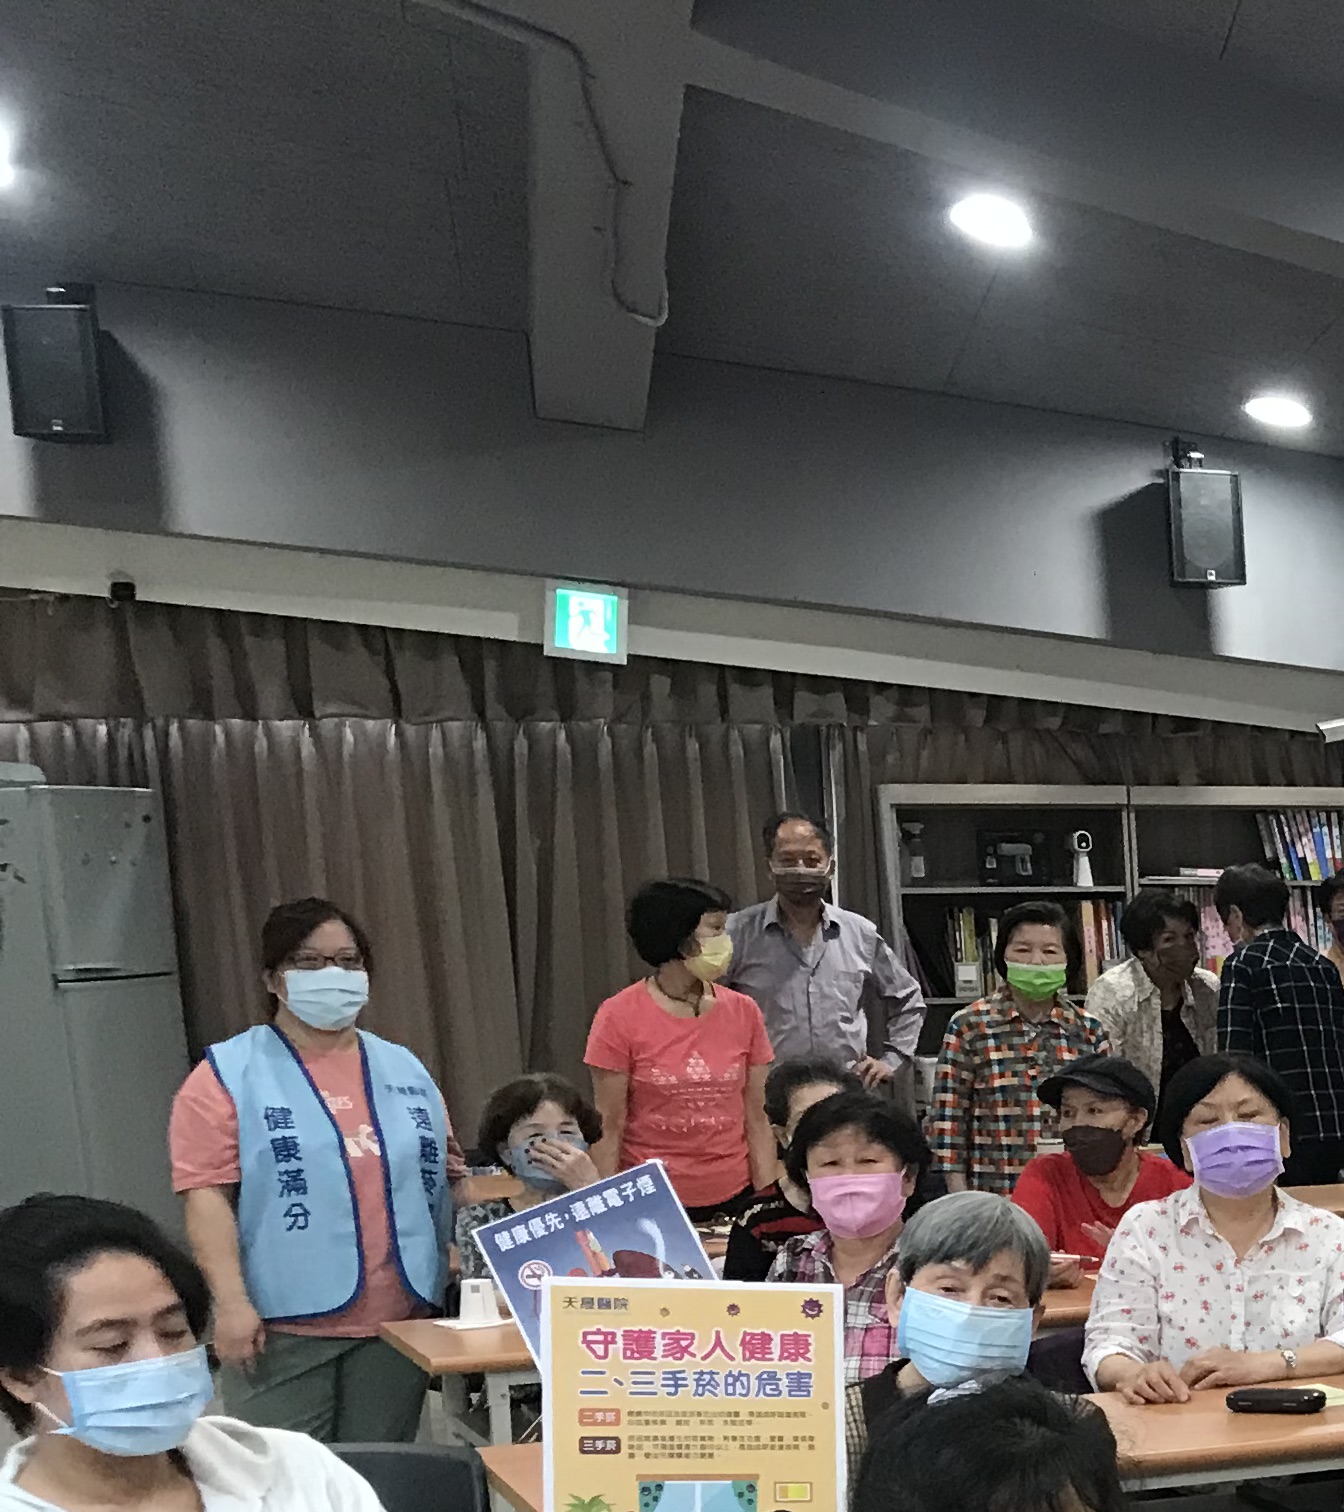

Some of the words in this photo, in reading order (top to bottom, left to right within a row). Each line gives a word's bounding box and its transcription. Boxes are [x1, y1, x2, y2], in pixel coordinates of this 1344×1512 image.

[264, 1105, 311, 1232] 健康滿分
[581, 1328, 813, 1363] 守護家人健康
[578, 1369, 814, 1398] 二、三手菸的危害
